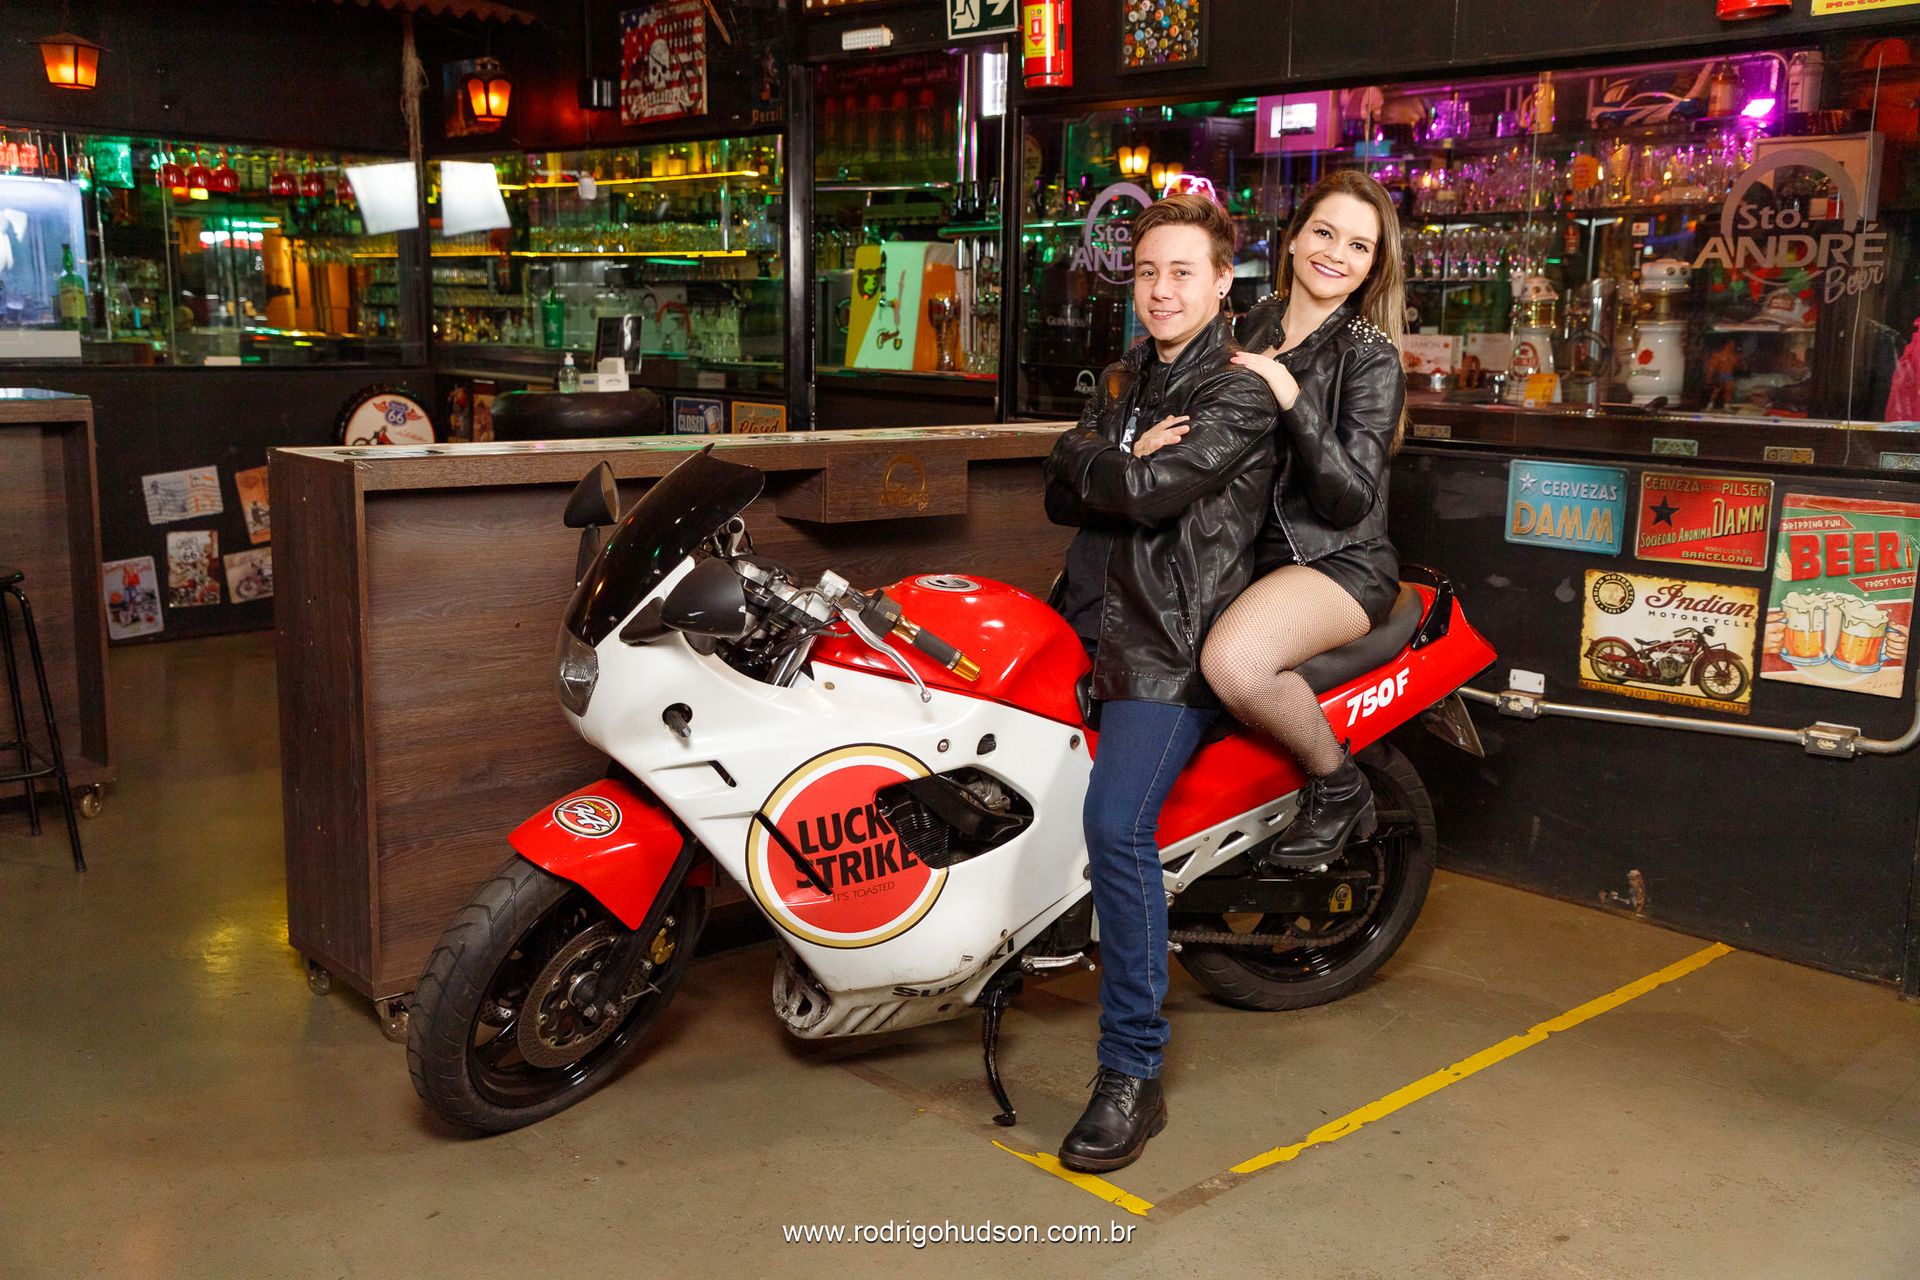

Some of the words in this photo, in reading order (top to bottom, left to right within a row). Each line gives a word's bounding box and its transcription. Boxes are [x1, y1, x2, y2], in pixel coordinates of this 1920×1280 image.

[1738, 203, 1809, 230] Sto.
[1691, 223, 1887, 269] ANDRÉ
[1824, 264, 1884, 304] Beer
[388, 410, 405, 424] 66
[678, 415, 705, 433] CLOSED
[739, 418, 780, 433] Closed
[1541, 480, 1618, 501] CERVEZAS
[1645, 478, 1699, 492] CERVEZA
[1722, 483, 1769, 497] PILSEN
[1512, 500, 1613, 544] DAMM
[1712, 498, 1766, 538] DAMM
[1782, 520, 1823, 531] DRIPPING
[1824, 519, 1841, 528] FUN
[1681, 551, 1753, 564] BARCELONA
[1790, 532, 1902, 581] BEER
[1864, 578, 1889, 588] FROST
[1645, 584, 1754, 618] Indian
[1648, 610, 1750, 628] MOTORCYCLE
[1580, 681, 1622, 695] MODEL
[1657, 693, 1702, 708] INDIAN
[1704, 700, 1748, 714] SCOUT
[797, 803, 893, 855] LUCK
[794, 838, 918, 889] STRIKE
[853, 881, 895, 899] TOASTED
[892, 937, 1015, 998] SUZKI
